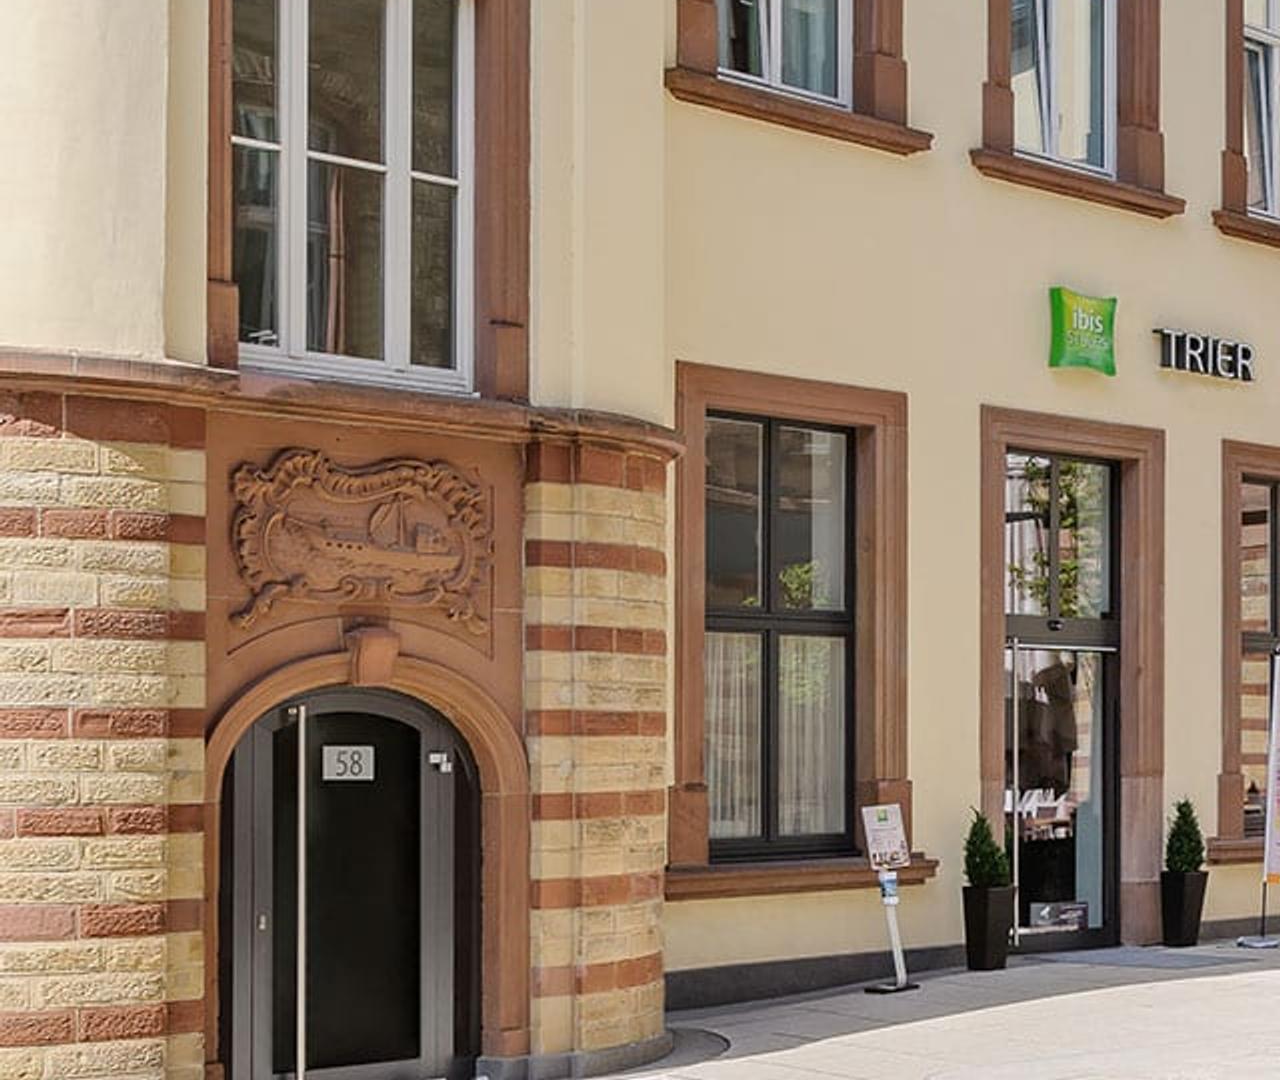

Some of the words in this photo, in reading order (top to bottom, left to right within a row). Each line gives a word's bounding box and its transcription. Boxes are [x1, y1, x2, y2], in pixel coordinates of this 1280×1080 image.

[1072, 305, 1104, 334] ibis
[1162, 328, 1254, 381] TRIER
[335, 749, 363, 777] 58
